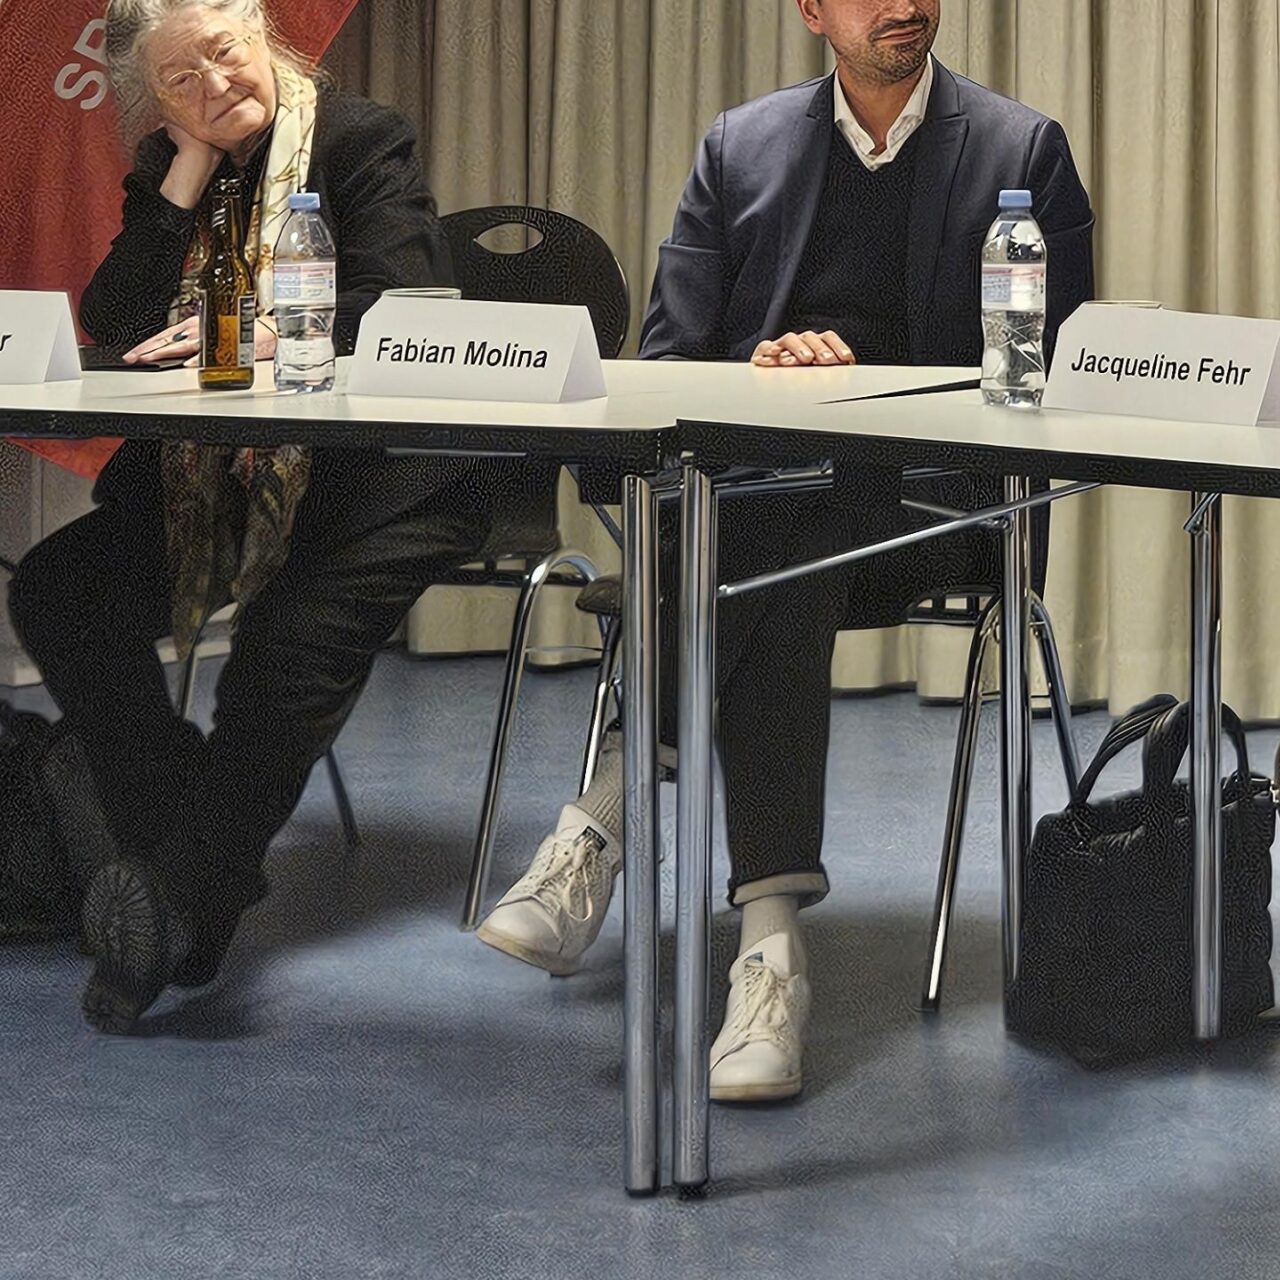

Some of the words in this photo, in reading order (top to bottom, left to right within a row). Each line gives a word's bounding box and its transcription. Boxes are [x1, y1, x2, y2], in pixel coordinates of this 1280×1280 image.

[376, 336, 456, 364] Fabian
[463, 340, 549, 369] Molina
[1071, 347, 1191, 382] Jacqueline
[1196, 357, 1252, 386] Fehr
